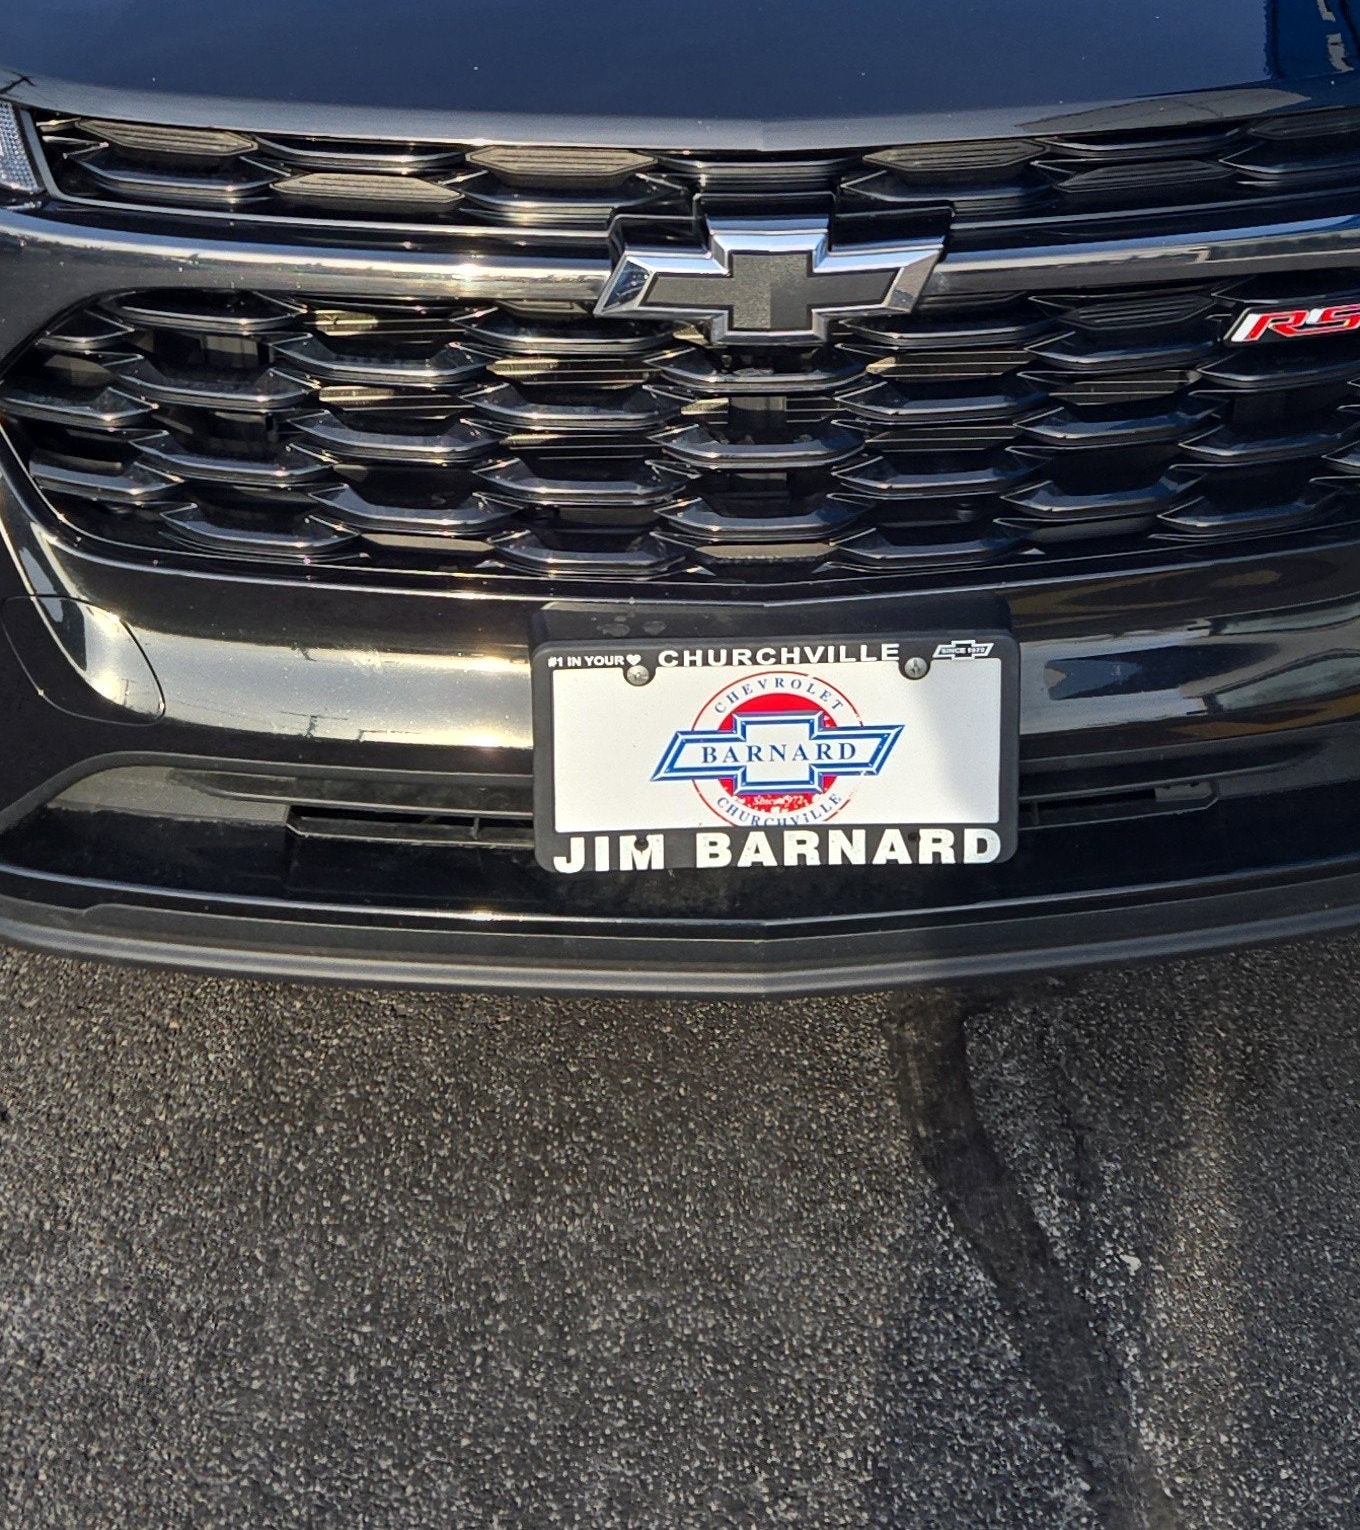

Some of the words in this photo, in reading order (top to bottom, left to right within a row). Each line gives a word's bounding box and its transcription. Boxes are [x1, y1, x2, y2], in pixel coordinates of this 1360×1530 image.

[566, 656, 582, 667] IN
[583, 655, 625, 666] YOUR
[657, 643, 900, 668] CHURCHVILLE
[714, 676, 844, 715] CHEVROLET
[701, 742, 857, 764] BARNARD
[717, 792, 842, 826] CHURCHVILLE
[553, 833, 665, 874] JIM
[695, 828, 1002, 869] BARNARD
